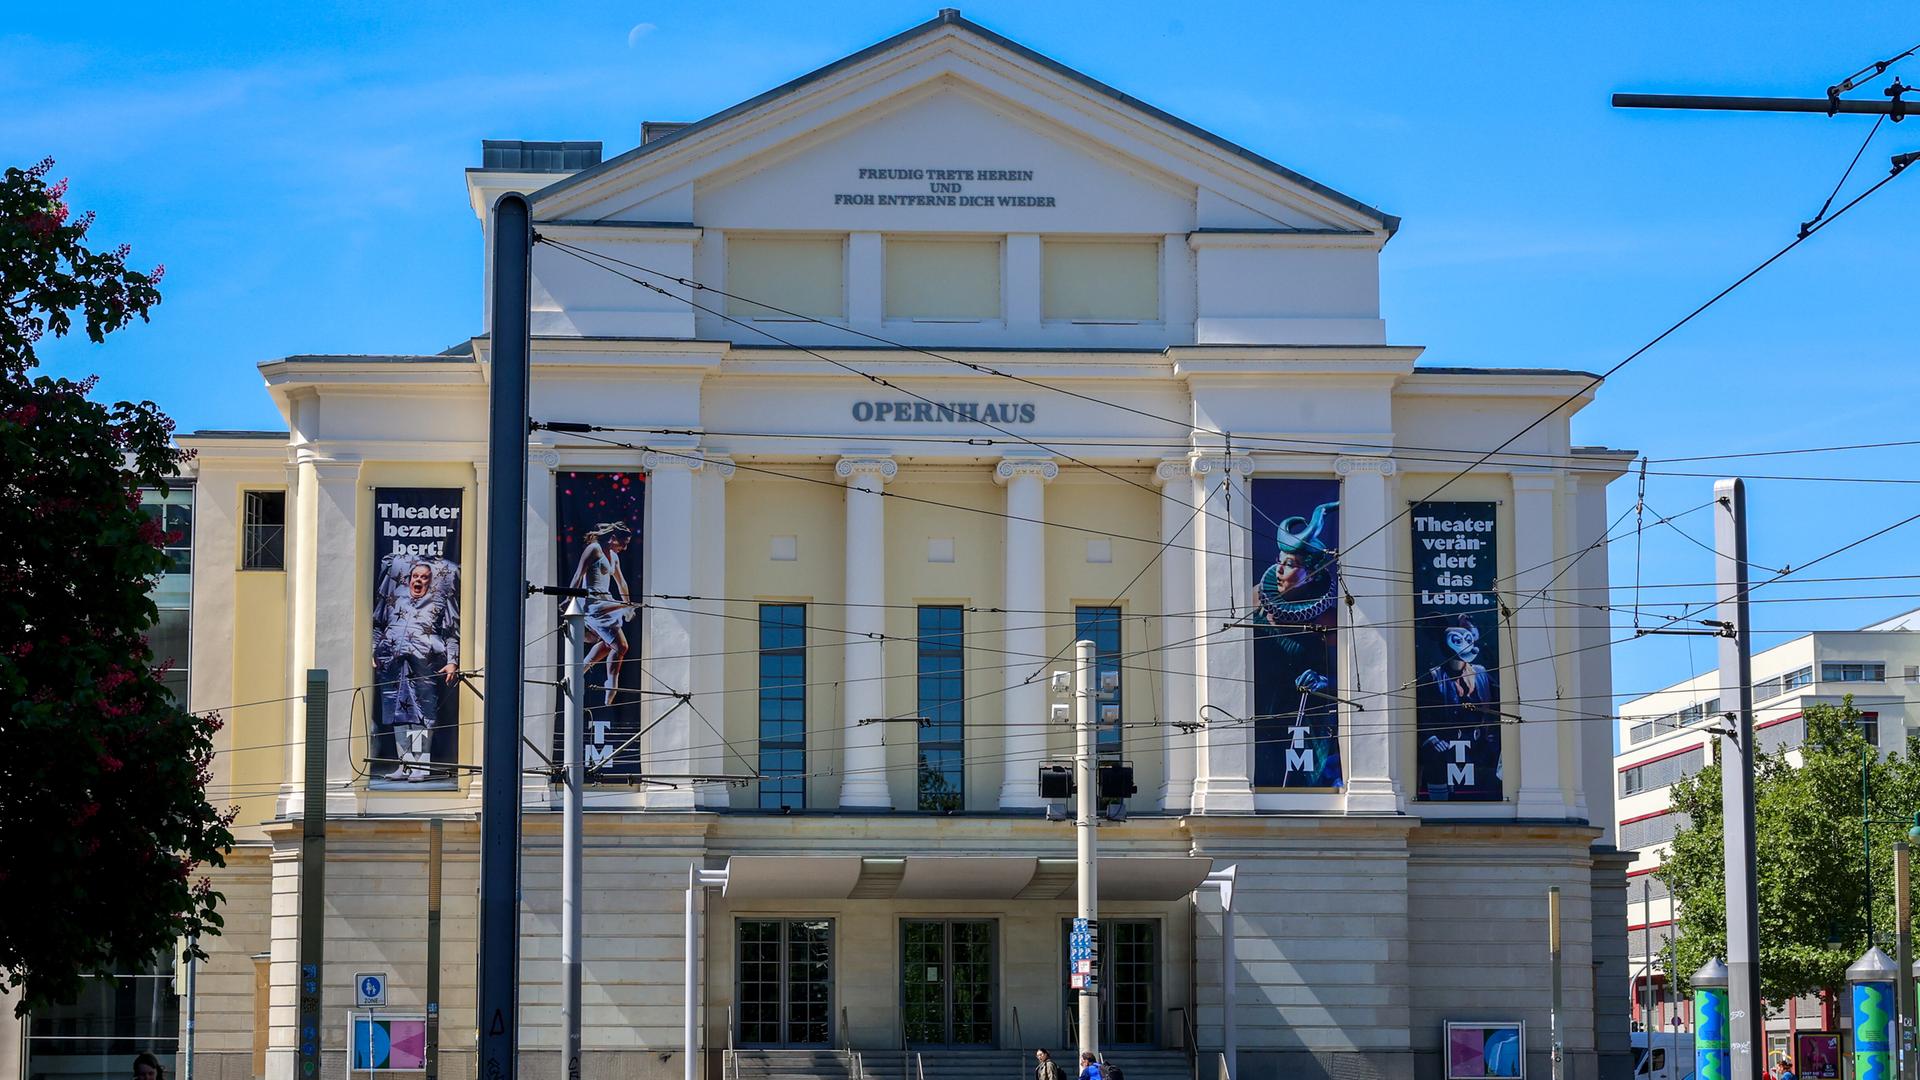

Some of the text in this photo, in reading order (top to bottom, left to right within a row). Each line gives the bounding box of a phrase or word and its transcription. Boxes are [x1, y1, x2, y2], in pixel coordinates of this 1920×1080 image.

[859, 168, 1033, 182] FREUDIG TRETE HEREIN
[930, 182, 961, 193] UND
[834, 194, 1056, 208] FROH ENTFERNE DICH WIEDER
[852, 401, 1036, 423] OPERNHAUS
[377, 503, 460, 519] Theater
[383, 521, 454, 537] bezau-
[1413, 516, 1494, 532] Theater
[392, 540, 444, 556] bert!
[1422, 534, 1487, 550] verän-
[1432, 553, 1477, 568] dert
[1437, 571, 1473, 587] das
[1421, 589, 1490, 605] Leben.
